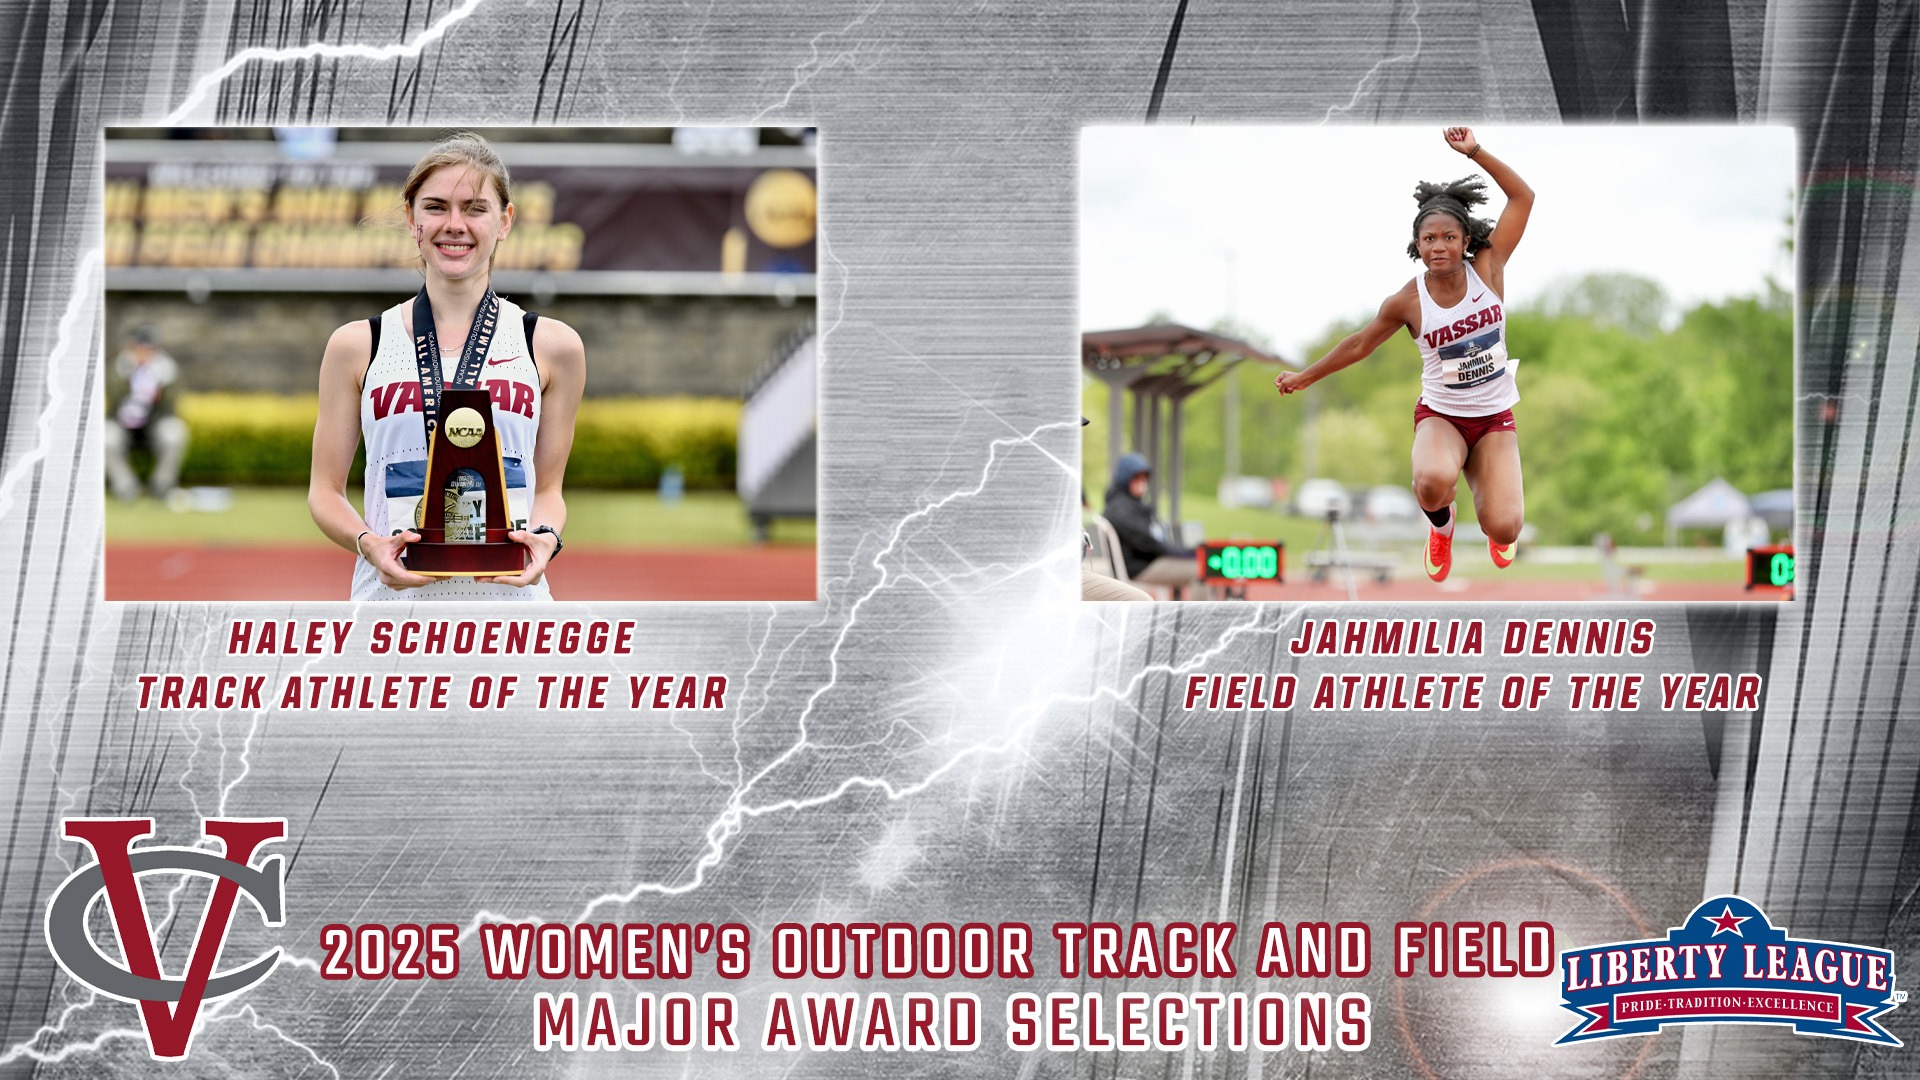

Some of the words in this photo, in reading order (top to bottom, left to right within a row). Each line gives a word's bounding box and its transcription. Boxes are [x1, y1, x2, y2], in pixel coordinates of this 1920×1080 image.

[1423, 304, 1503, 349] VASSAR
[1457, 353, 1493, 371] JAHMILIA
[1458, 362, 1495, 381] DENNIS
[370, 379, 535, 421] VAAR
[448, 426, 484, 437] NCAA
